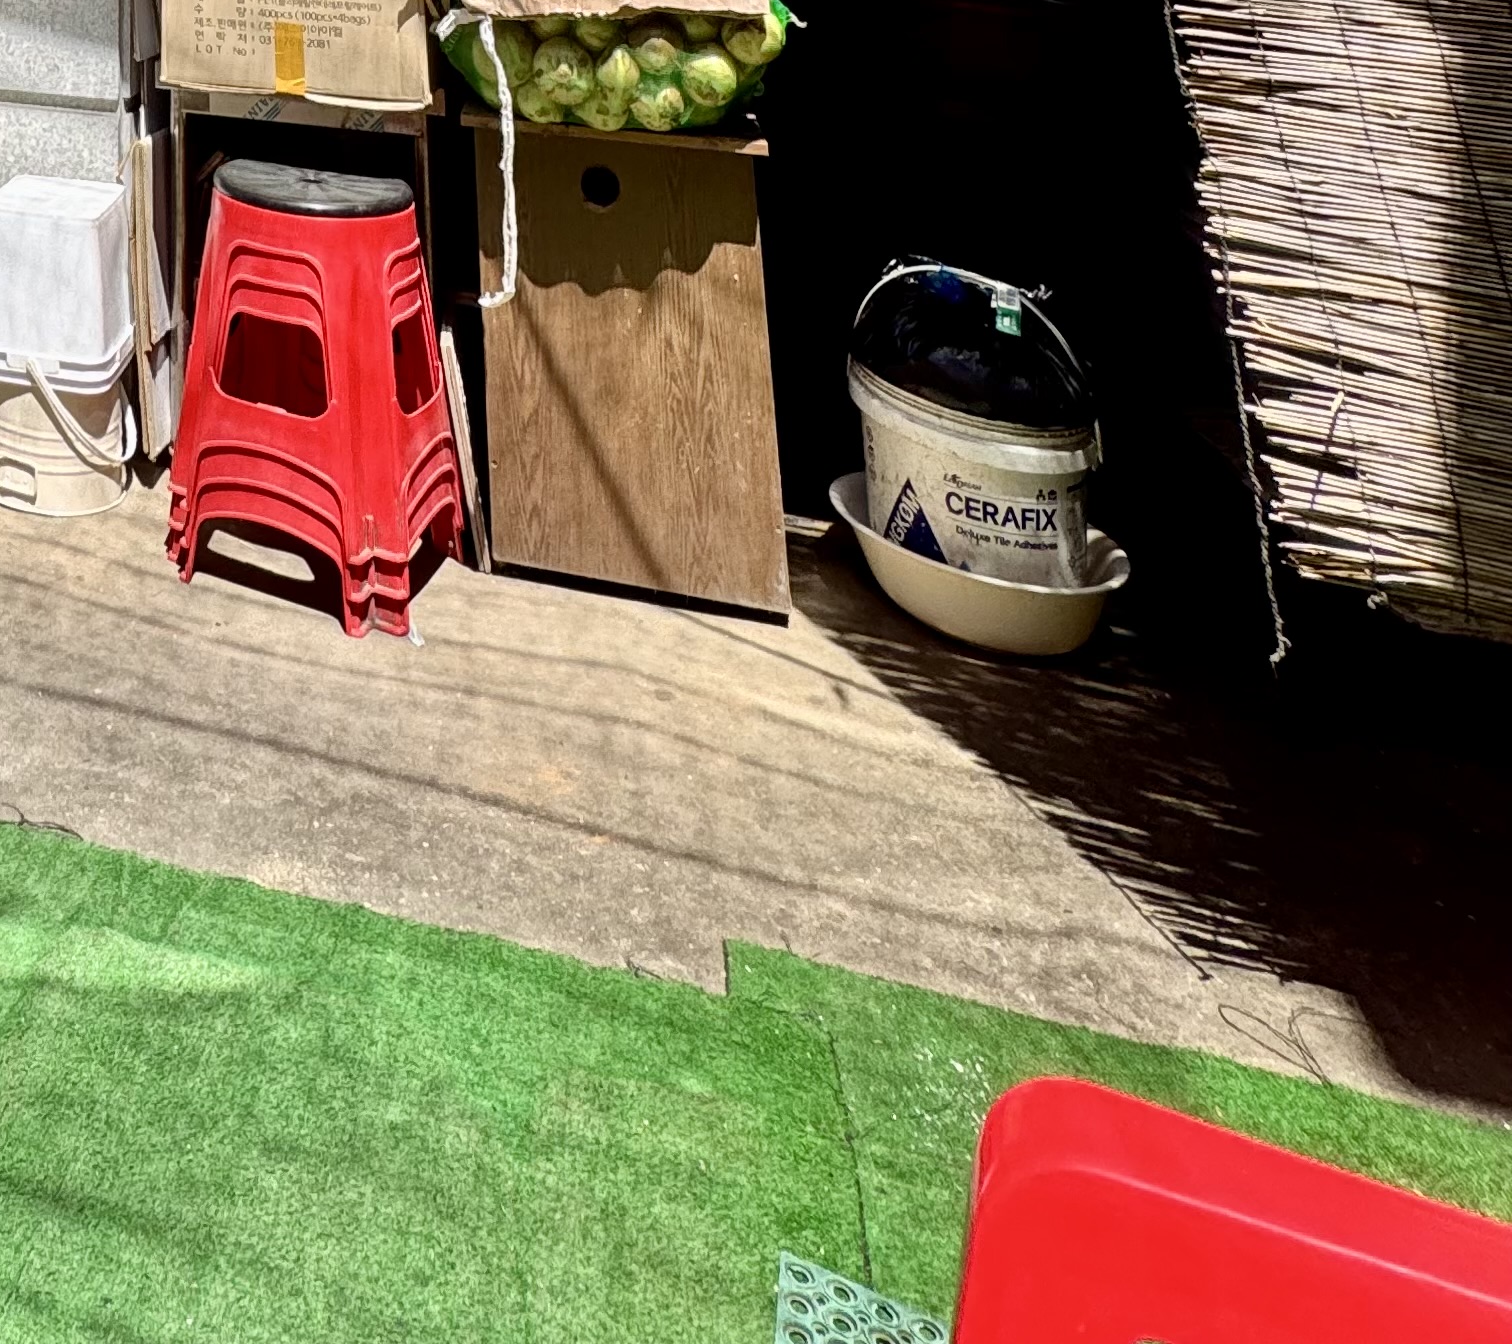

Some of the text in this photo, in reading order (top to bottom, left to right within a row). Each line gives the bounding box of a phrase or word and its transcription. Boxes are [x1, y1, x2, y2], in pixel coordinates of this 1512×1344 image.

[944, 491, 1058, 532] CERAFIX
[955, 524, 991, 547] Deluxe
[994, 535, 1011, 547] Tile
